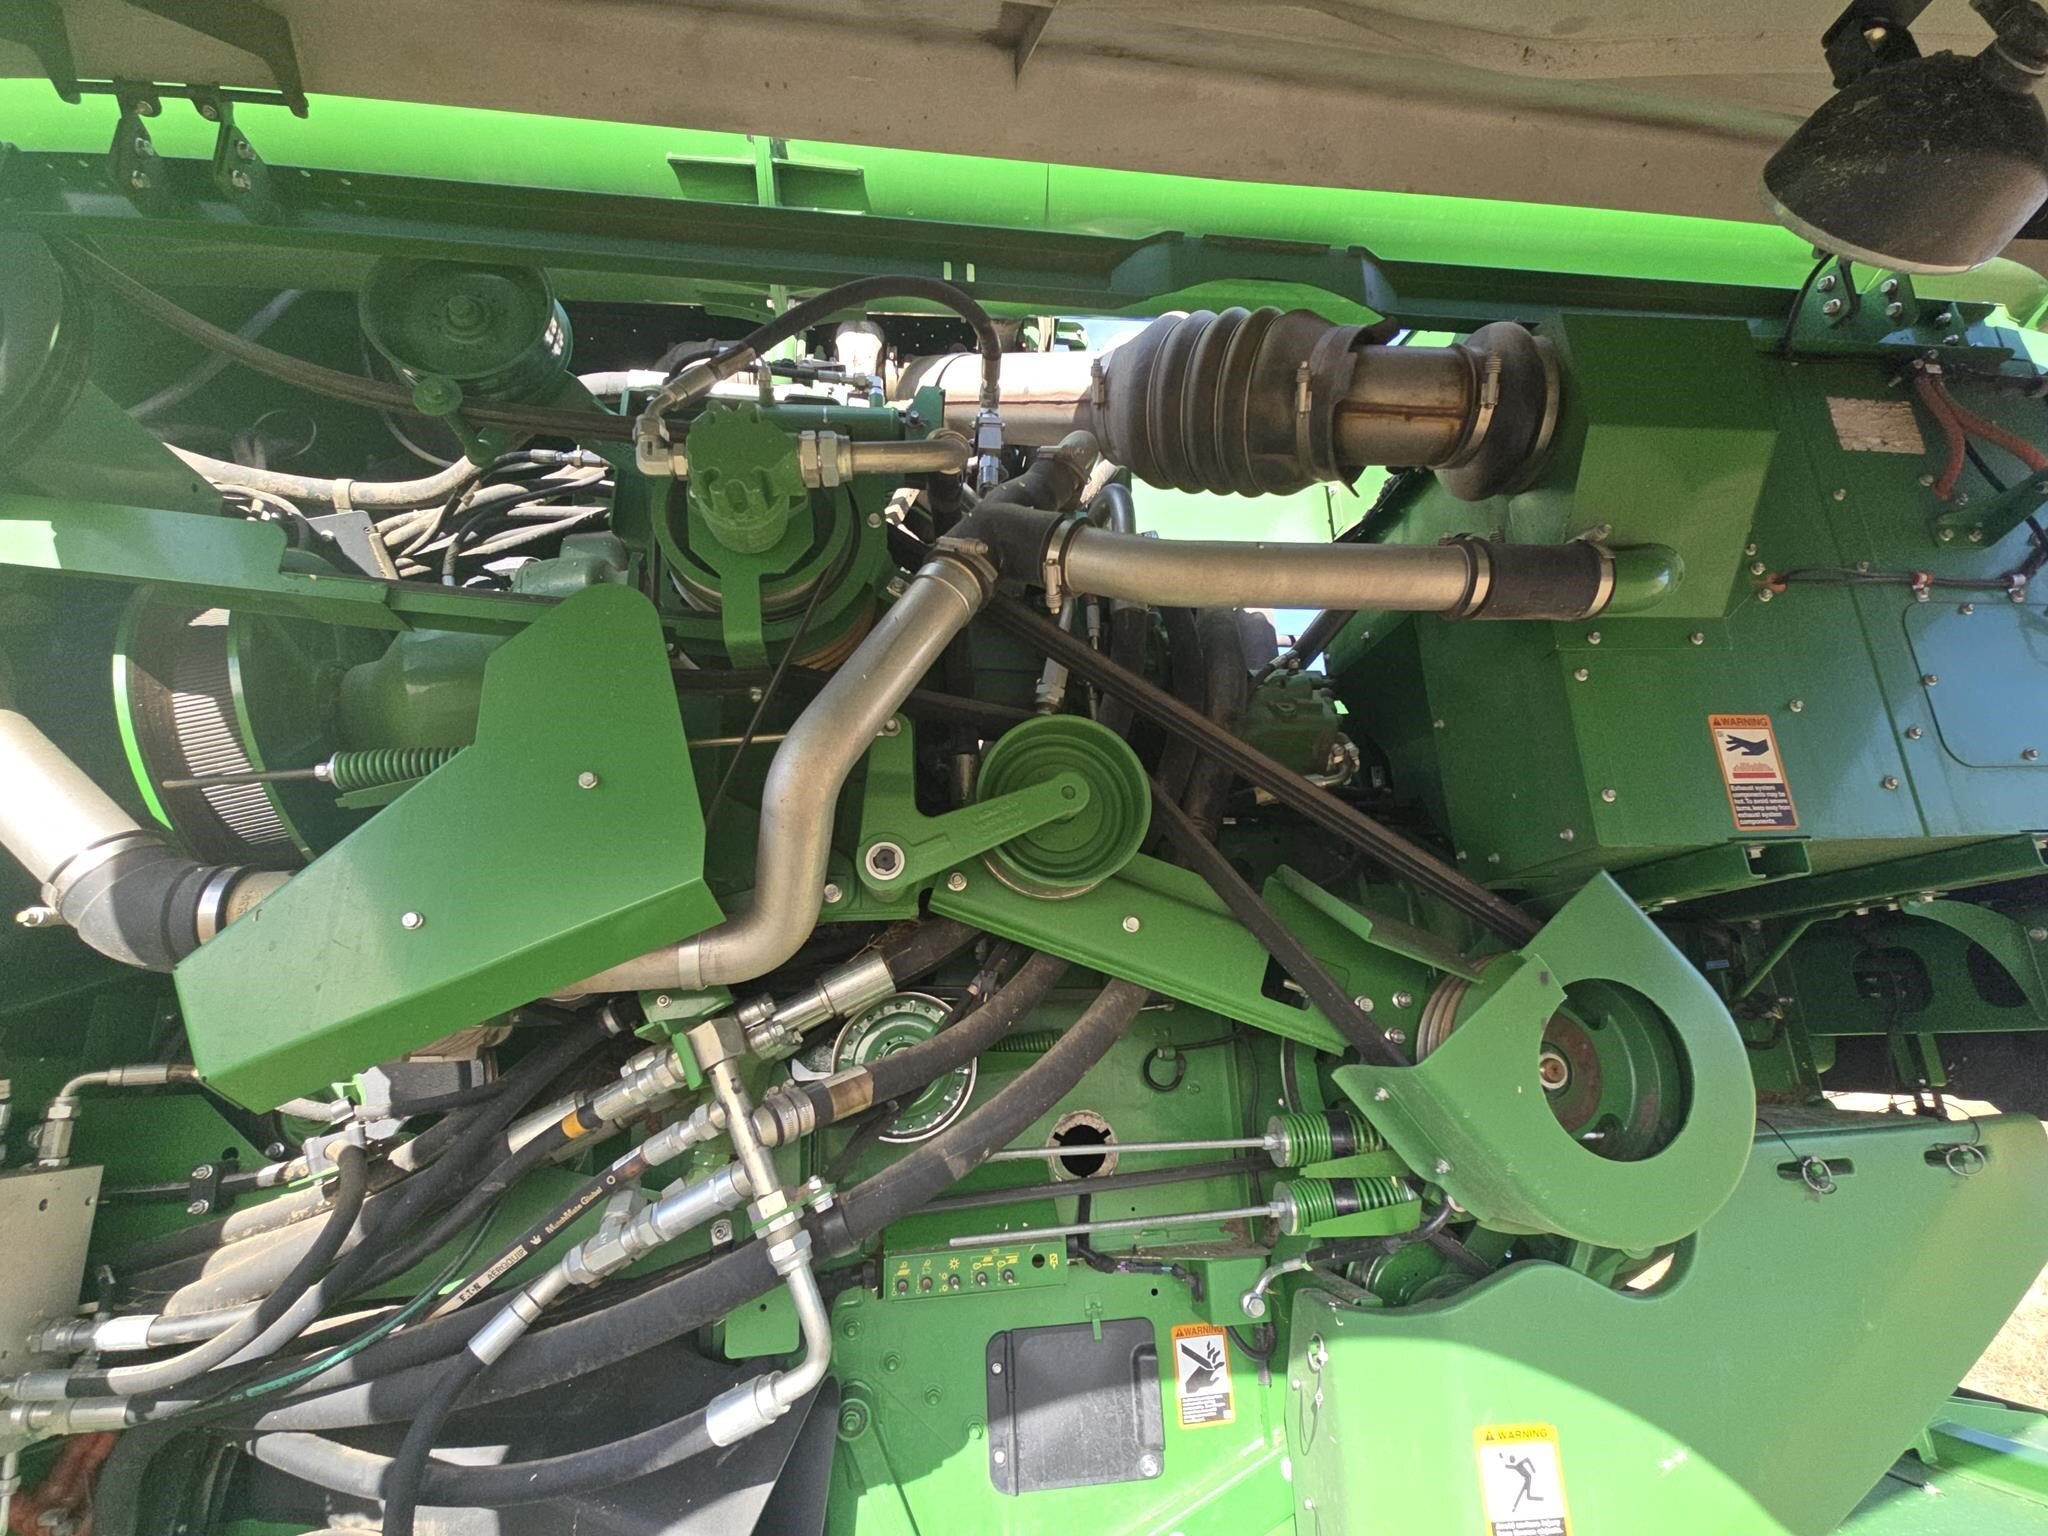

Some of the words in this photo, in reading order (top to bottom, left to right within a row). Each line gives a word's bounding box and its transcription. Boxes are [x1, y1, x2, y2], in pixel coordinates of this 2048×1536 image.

[1722, 717, 1768, 726] WARNING
[487, 1249, 525, 1281] AEROQUIP
[580, 1186, 603, 1206] Global
[1185, 1326, 1223, 1337] WARNING
[1498, 1428, 1548, 1440] WARNING
